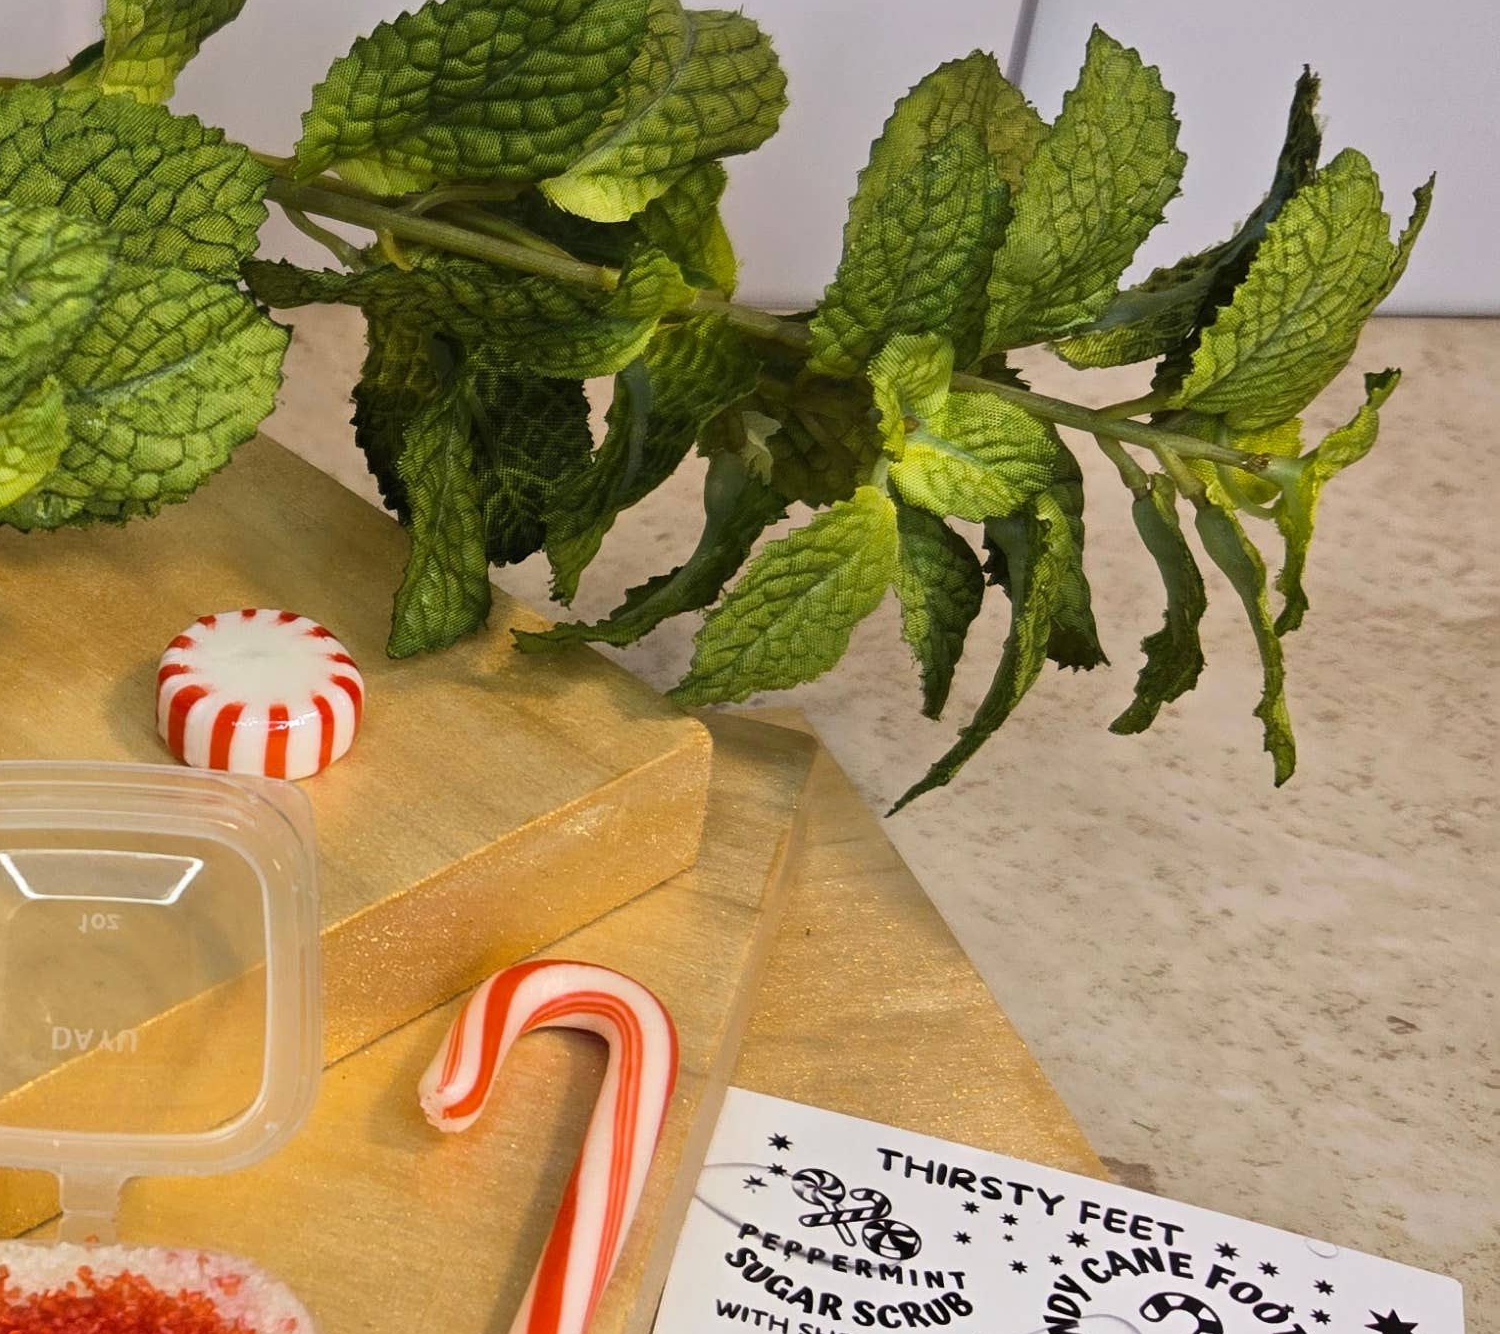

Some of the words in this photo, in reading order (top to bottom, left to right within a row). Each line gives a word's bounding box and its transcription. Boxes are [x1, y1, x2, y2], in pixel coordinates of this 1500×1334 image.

[875, 1146, 1066, 1217] THIRSTY
[1078, 1199, 1186, 1247] FEET
[725, 1247, 842, 1321] SUGAR
[852, 1291, 973, 1328] SCRUB
[737, 1223, 966, 1289] PEPPERMINT
[1081, 1247, 1194, 1284] CANE
